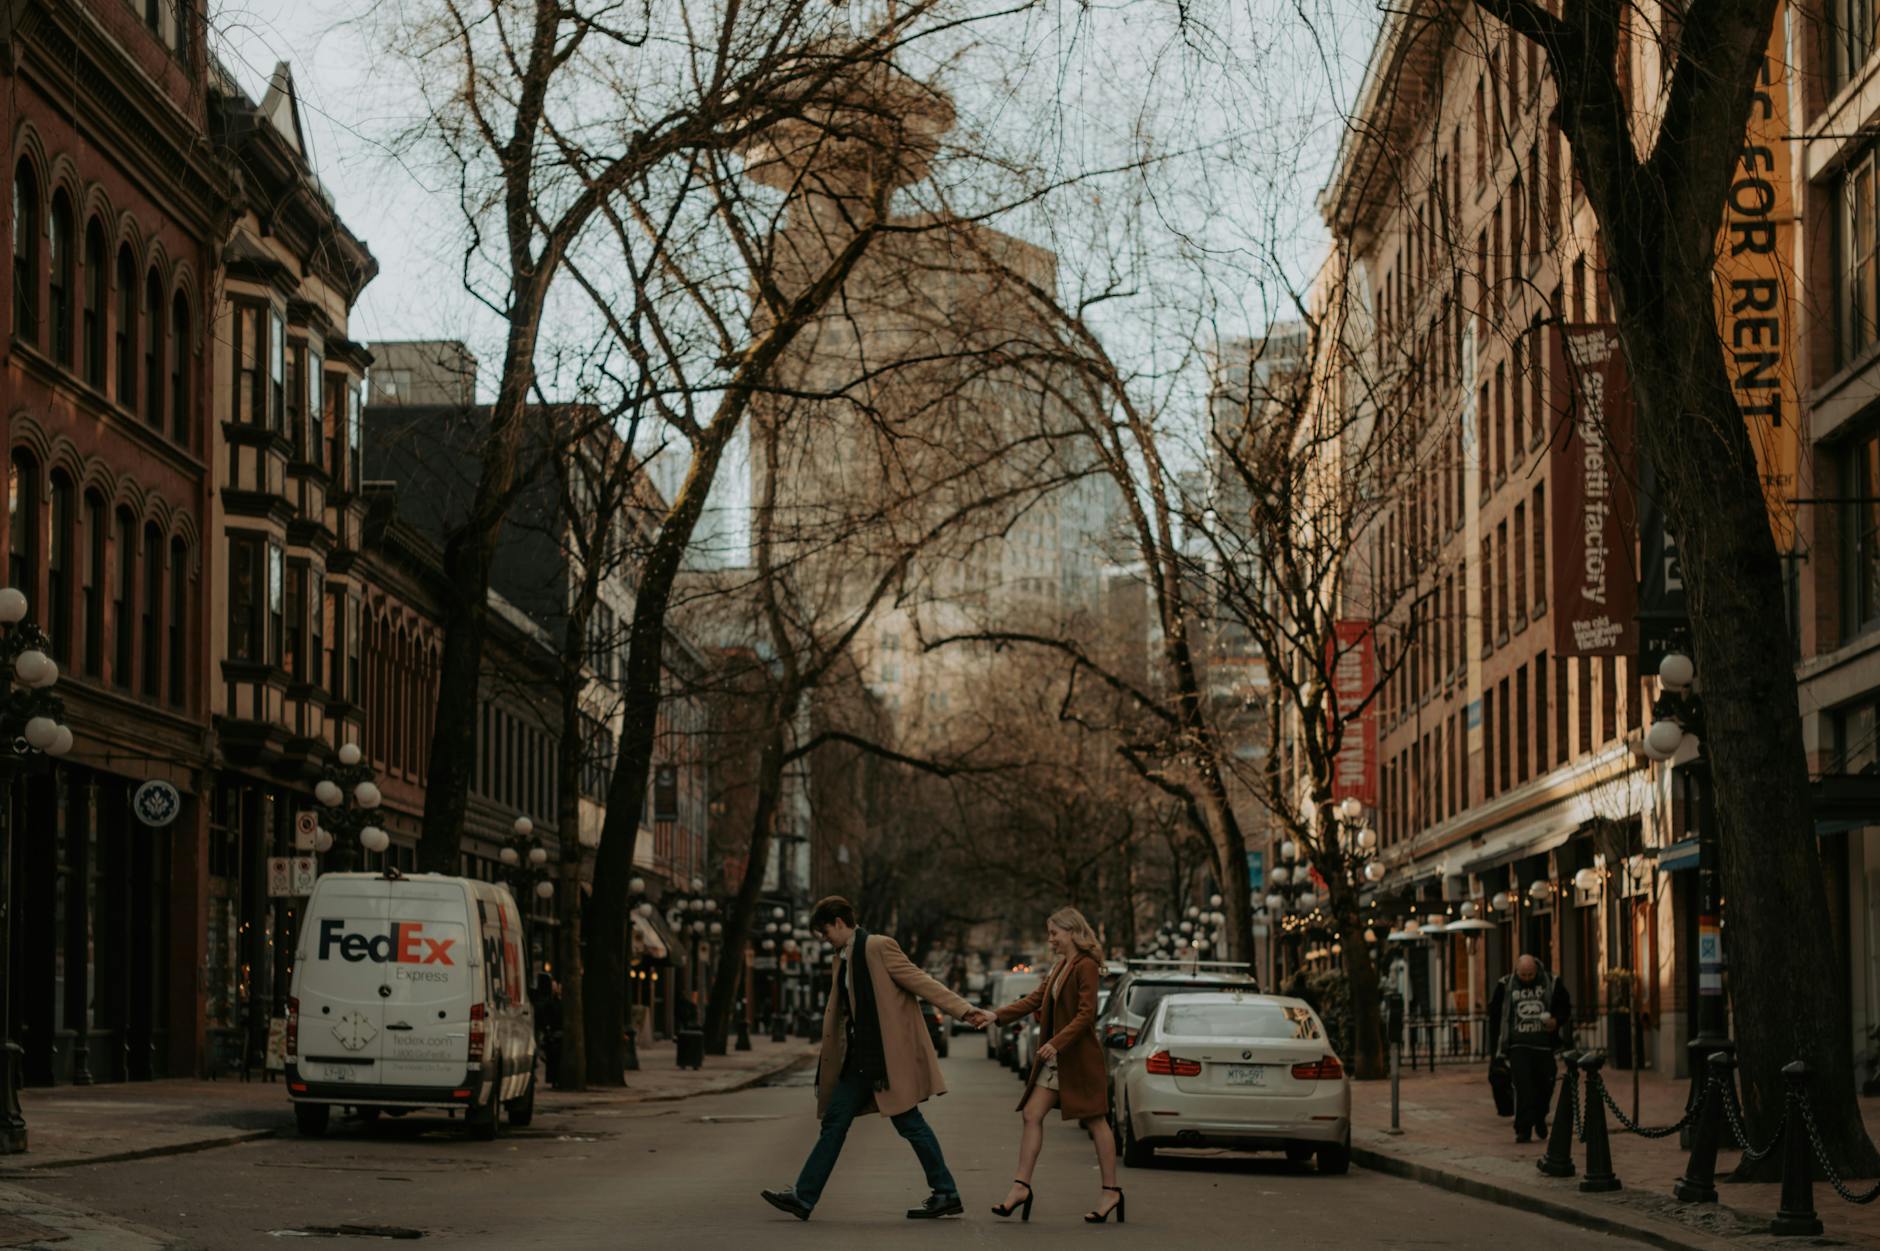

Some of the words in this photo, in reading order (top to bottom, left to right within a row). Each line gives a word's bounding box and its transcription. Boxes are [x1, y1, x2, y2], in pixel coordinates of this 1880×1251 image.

[1729, 145, 1776, 257] FOR
[1731, 278, 1782, 428] RENT
[1580, 501, 1610, 605] factory
[318, 918, 456, 966] FedEx
[396, 967, 450, 983] Express
